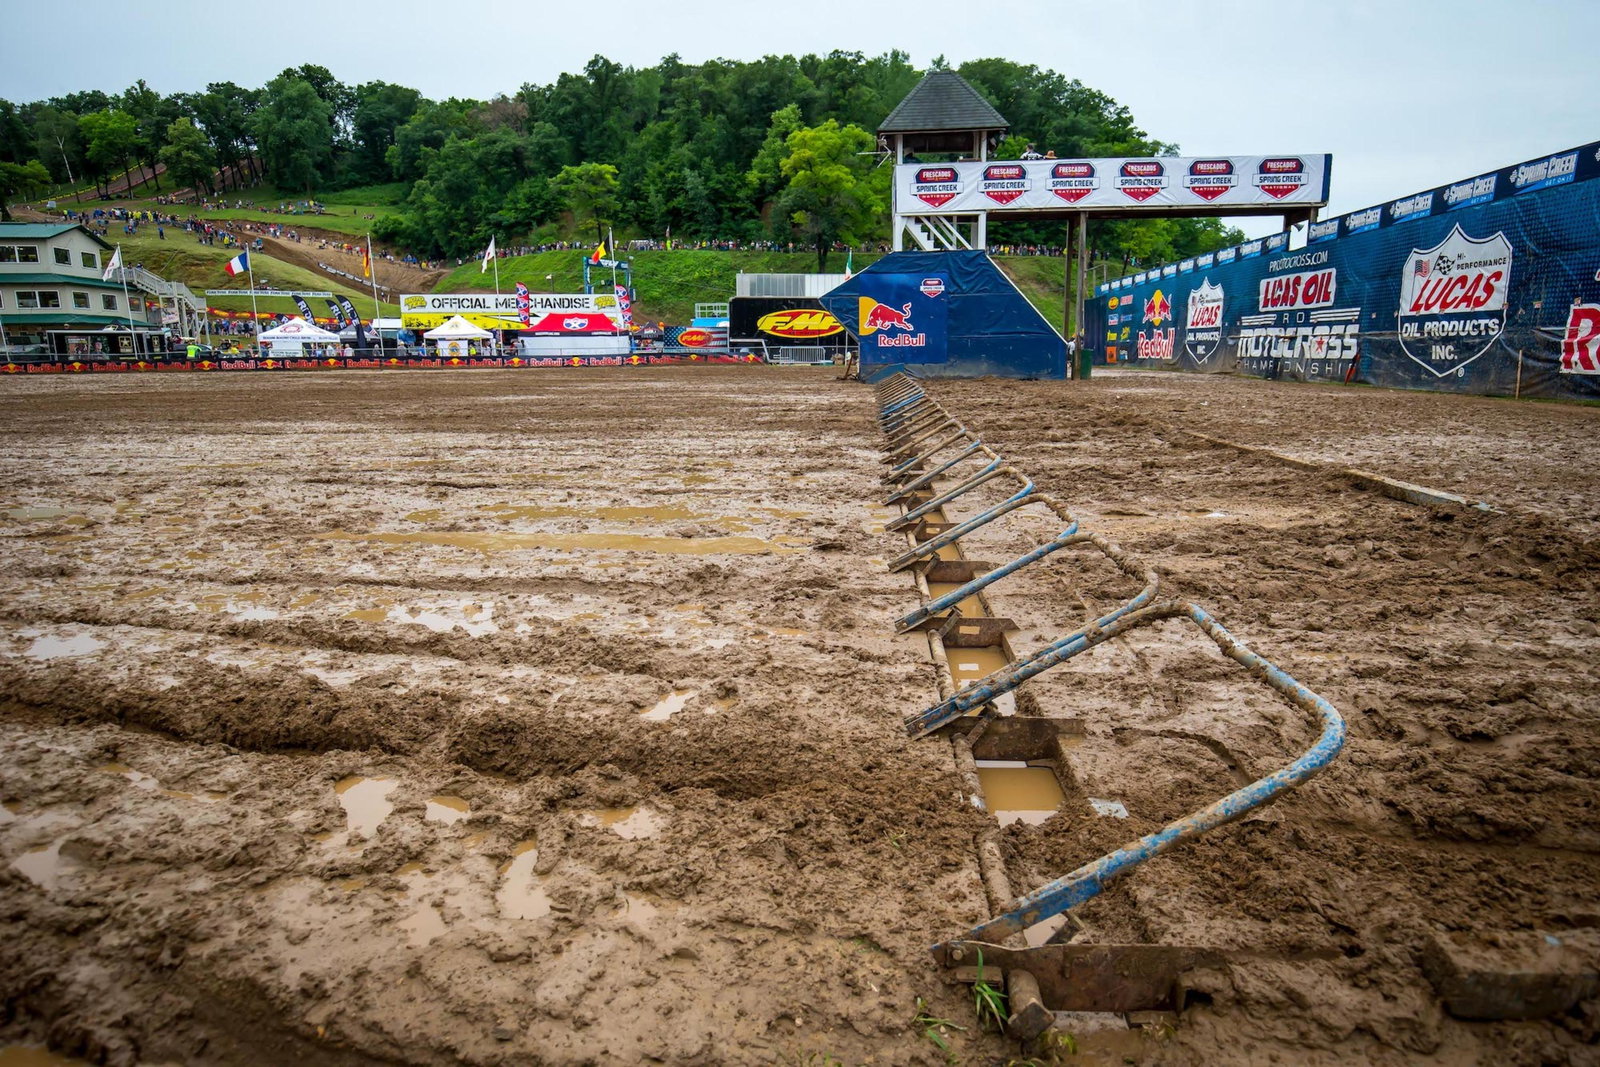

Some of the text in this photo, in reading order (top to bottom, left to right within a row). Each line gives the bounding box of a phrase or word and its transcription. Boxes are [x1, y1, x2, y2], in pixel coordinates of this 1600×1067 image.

[1006, 181, 1025, 189] CREEK
[1143, 178, 1162, 186] CREEK
[1457, 257, 1507, 270] PERFORMANCE
[1301, 271, 1333, 306] OIL
[1409, 271, 1503, 312] LUCAS
[431, 297, 590, 309] OFFICIAL MECHANDISE
[341, 300, 360, 327] RIDE
[758, 311, 842, 331] FMF
[1190, 305, 1221, 327] LUCAS
[1402, 318, 1500, 337] OIL PRODUCTS
[1431, 344, 1458, 360] INC.
[1236, 358, 1355, 376] CHAMPIONSHI
